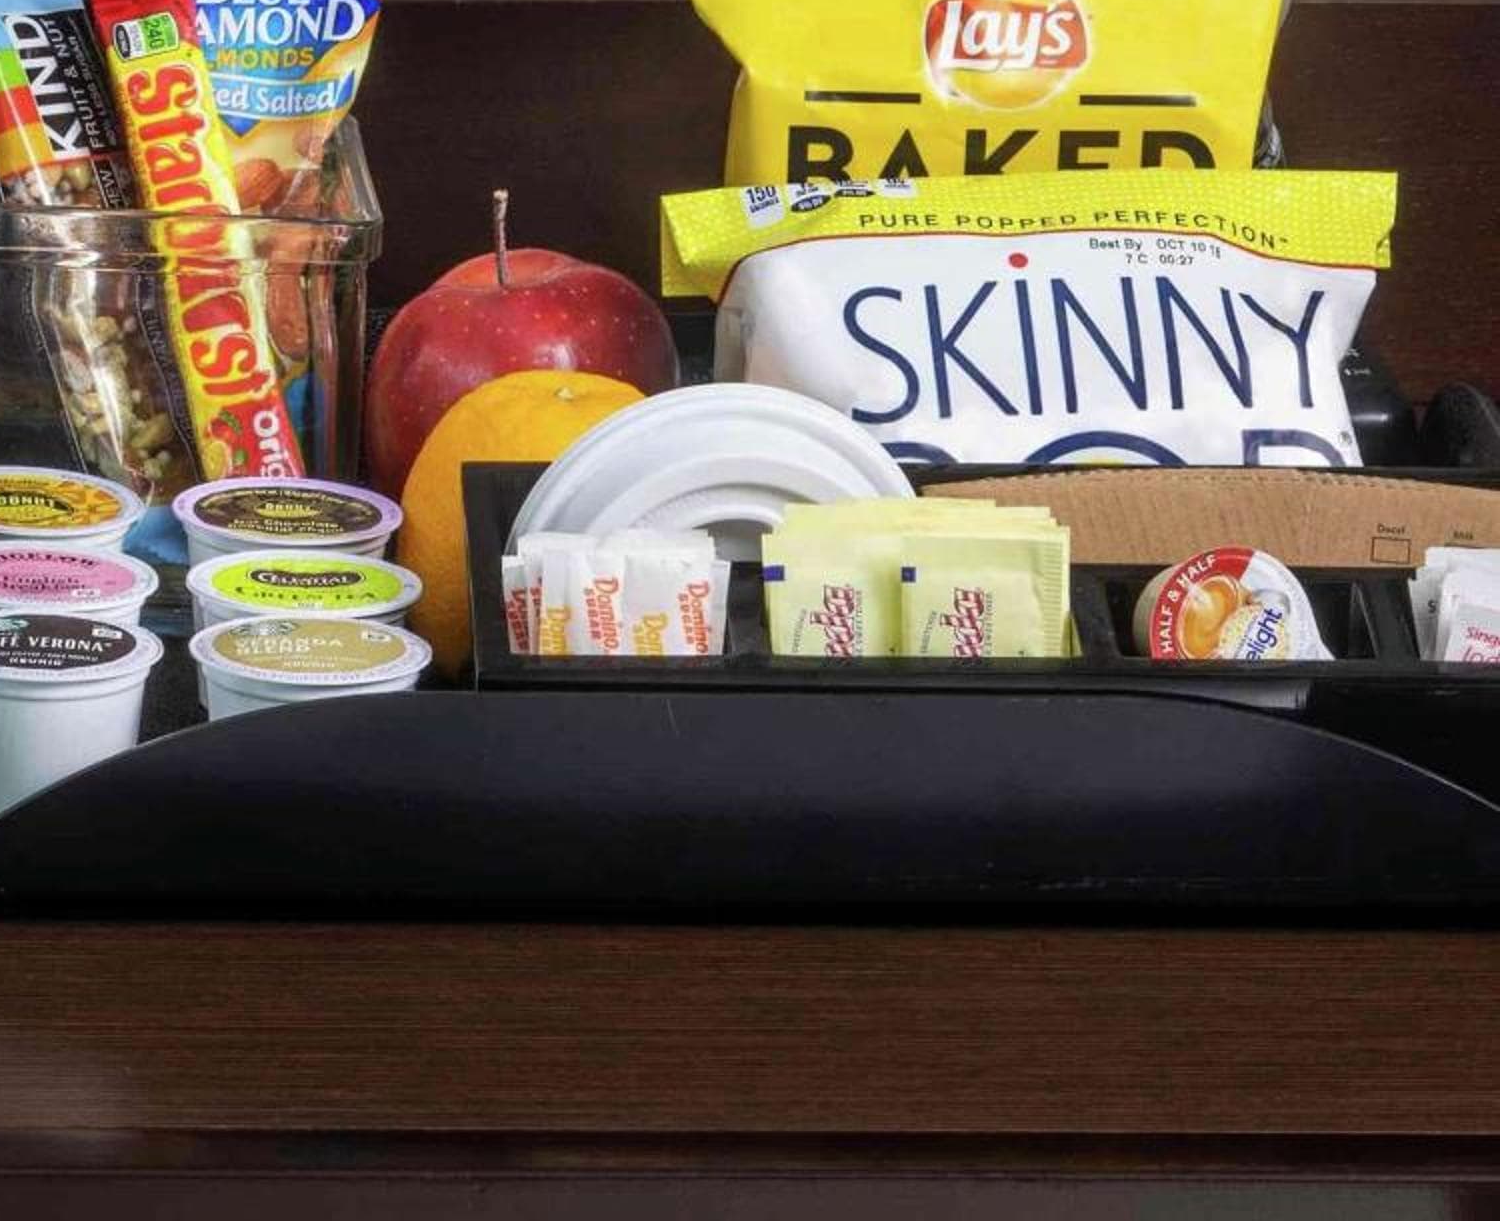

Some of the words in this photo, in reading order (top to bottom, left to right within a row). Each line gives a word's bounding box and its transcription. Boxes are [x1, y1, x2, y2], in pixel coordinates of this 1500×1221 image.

[41, 17, 70, 58] NUT
[207, 47, 316, 70] MONDS
[4, 12, 91, 160] KIND
[64, 65, 79, 78] &
[71, 85, 104, 149] FRUIT
[256, 82, 337, 114] Salted
[858, 214, 939, 228] PURE
[956, 213, 1077, 229] POPPED
[1088, 237, 1121, 250] Best
[1124, 238, 1142, 252] By
[1156, 238, 1185, 250] OCT
[252, 410, 292, 478] Orig
[583, 587, 602, 641] SUGAR
[594, 575, 620, 650] Domino
[687, 580, 710, 654] Domino
[1159, 604, 1175, 654] HALF
[1167, 589, 1182, 603] &
[1176, 554, 1217, 590] HALF
[28, 635, 103, 652] VERONA
[546, 605, 572, 656] Dom
[643, 611, 670, 656] Dom
[1245, 607, 1283, 664] elight
